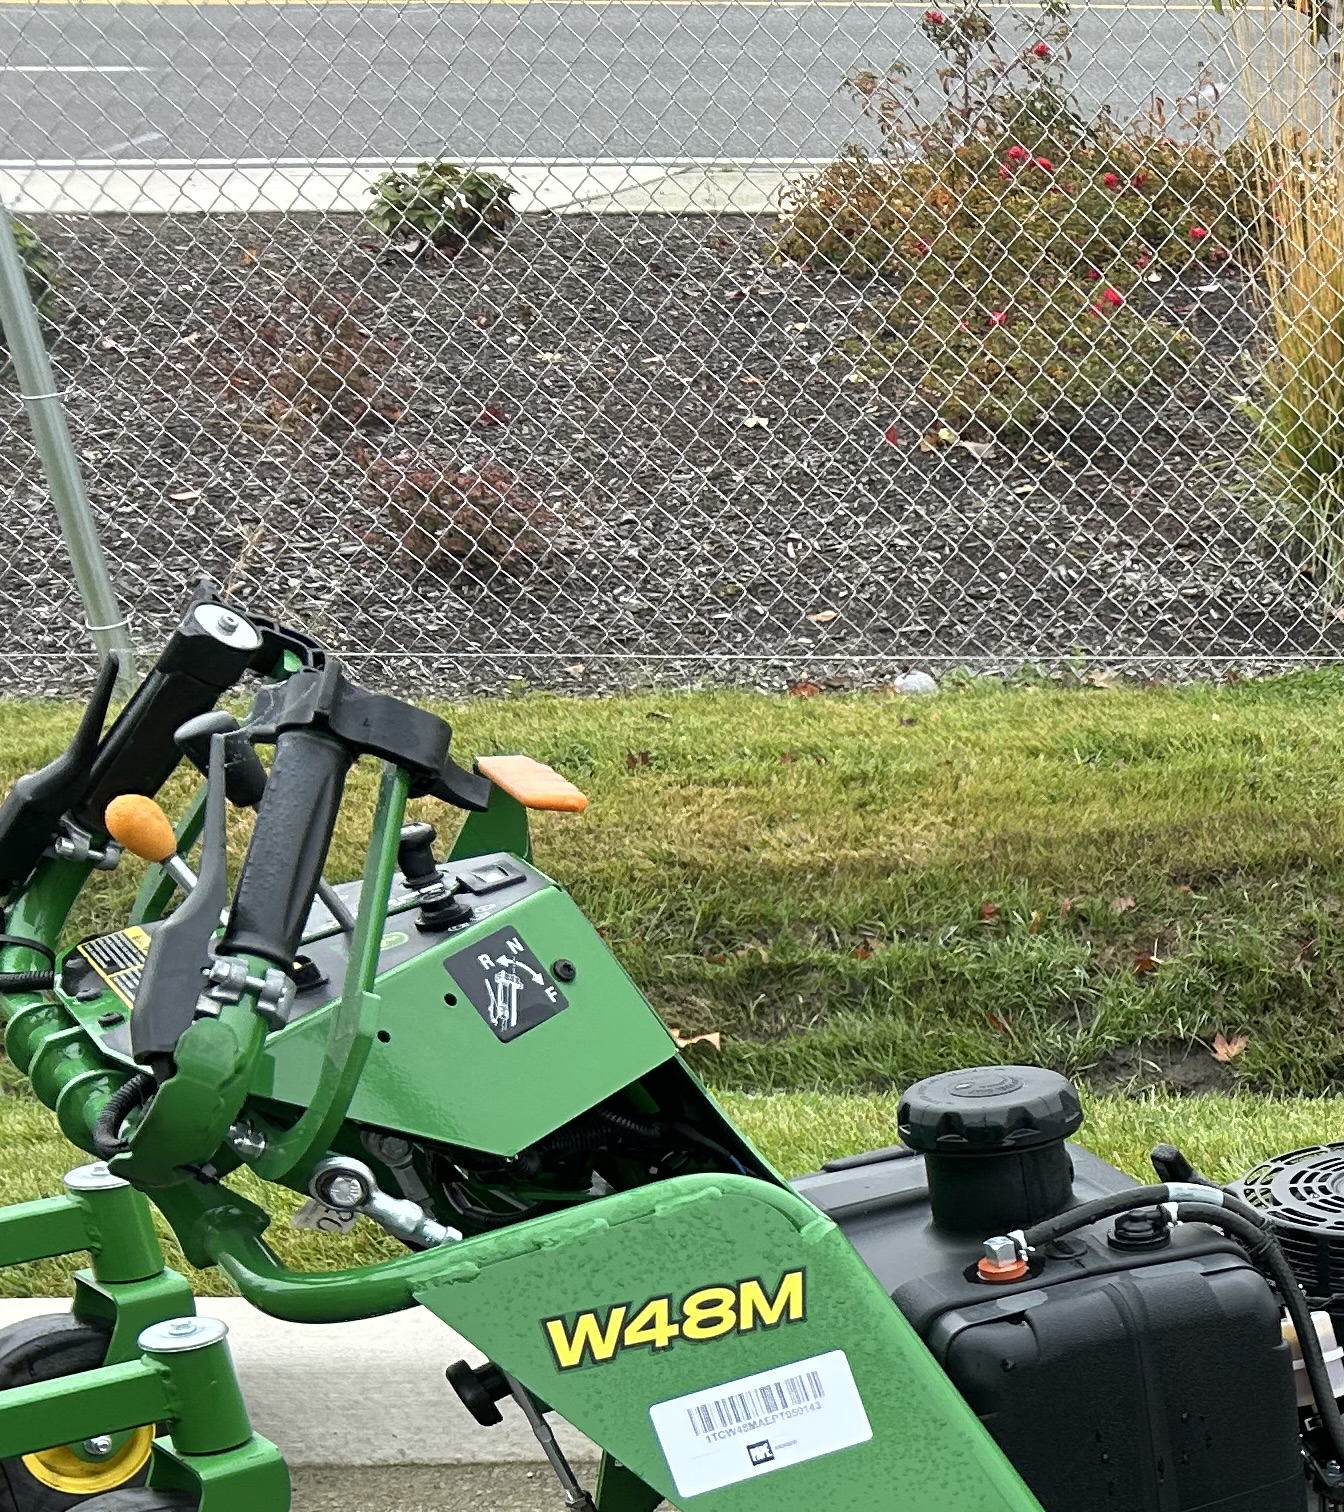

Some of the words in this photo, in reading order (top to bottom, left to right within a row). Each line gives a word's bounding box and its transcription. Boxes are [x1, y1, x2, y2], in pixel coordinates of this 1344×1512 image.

[505, 937, 525, 955] N
[477, 953, 496, 970] R
[544, 985, 558, 1003] F
[545, 1270, 804, 1369] W48M
